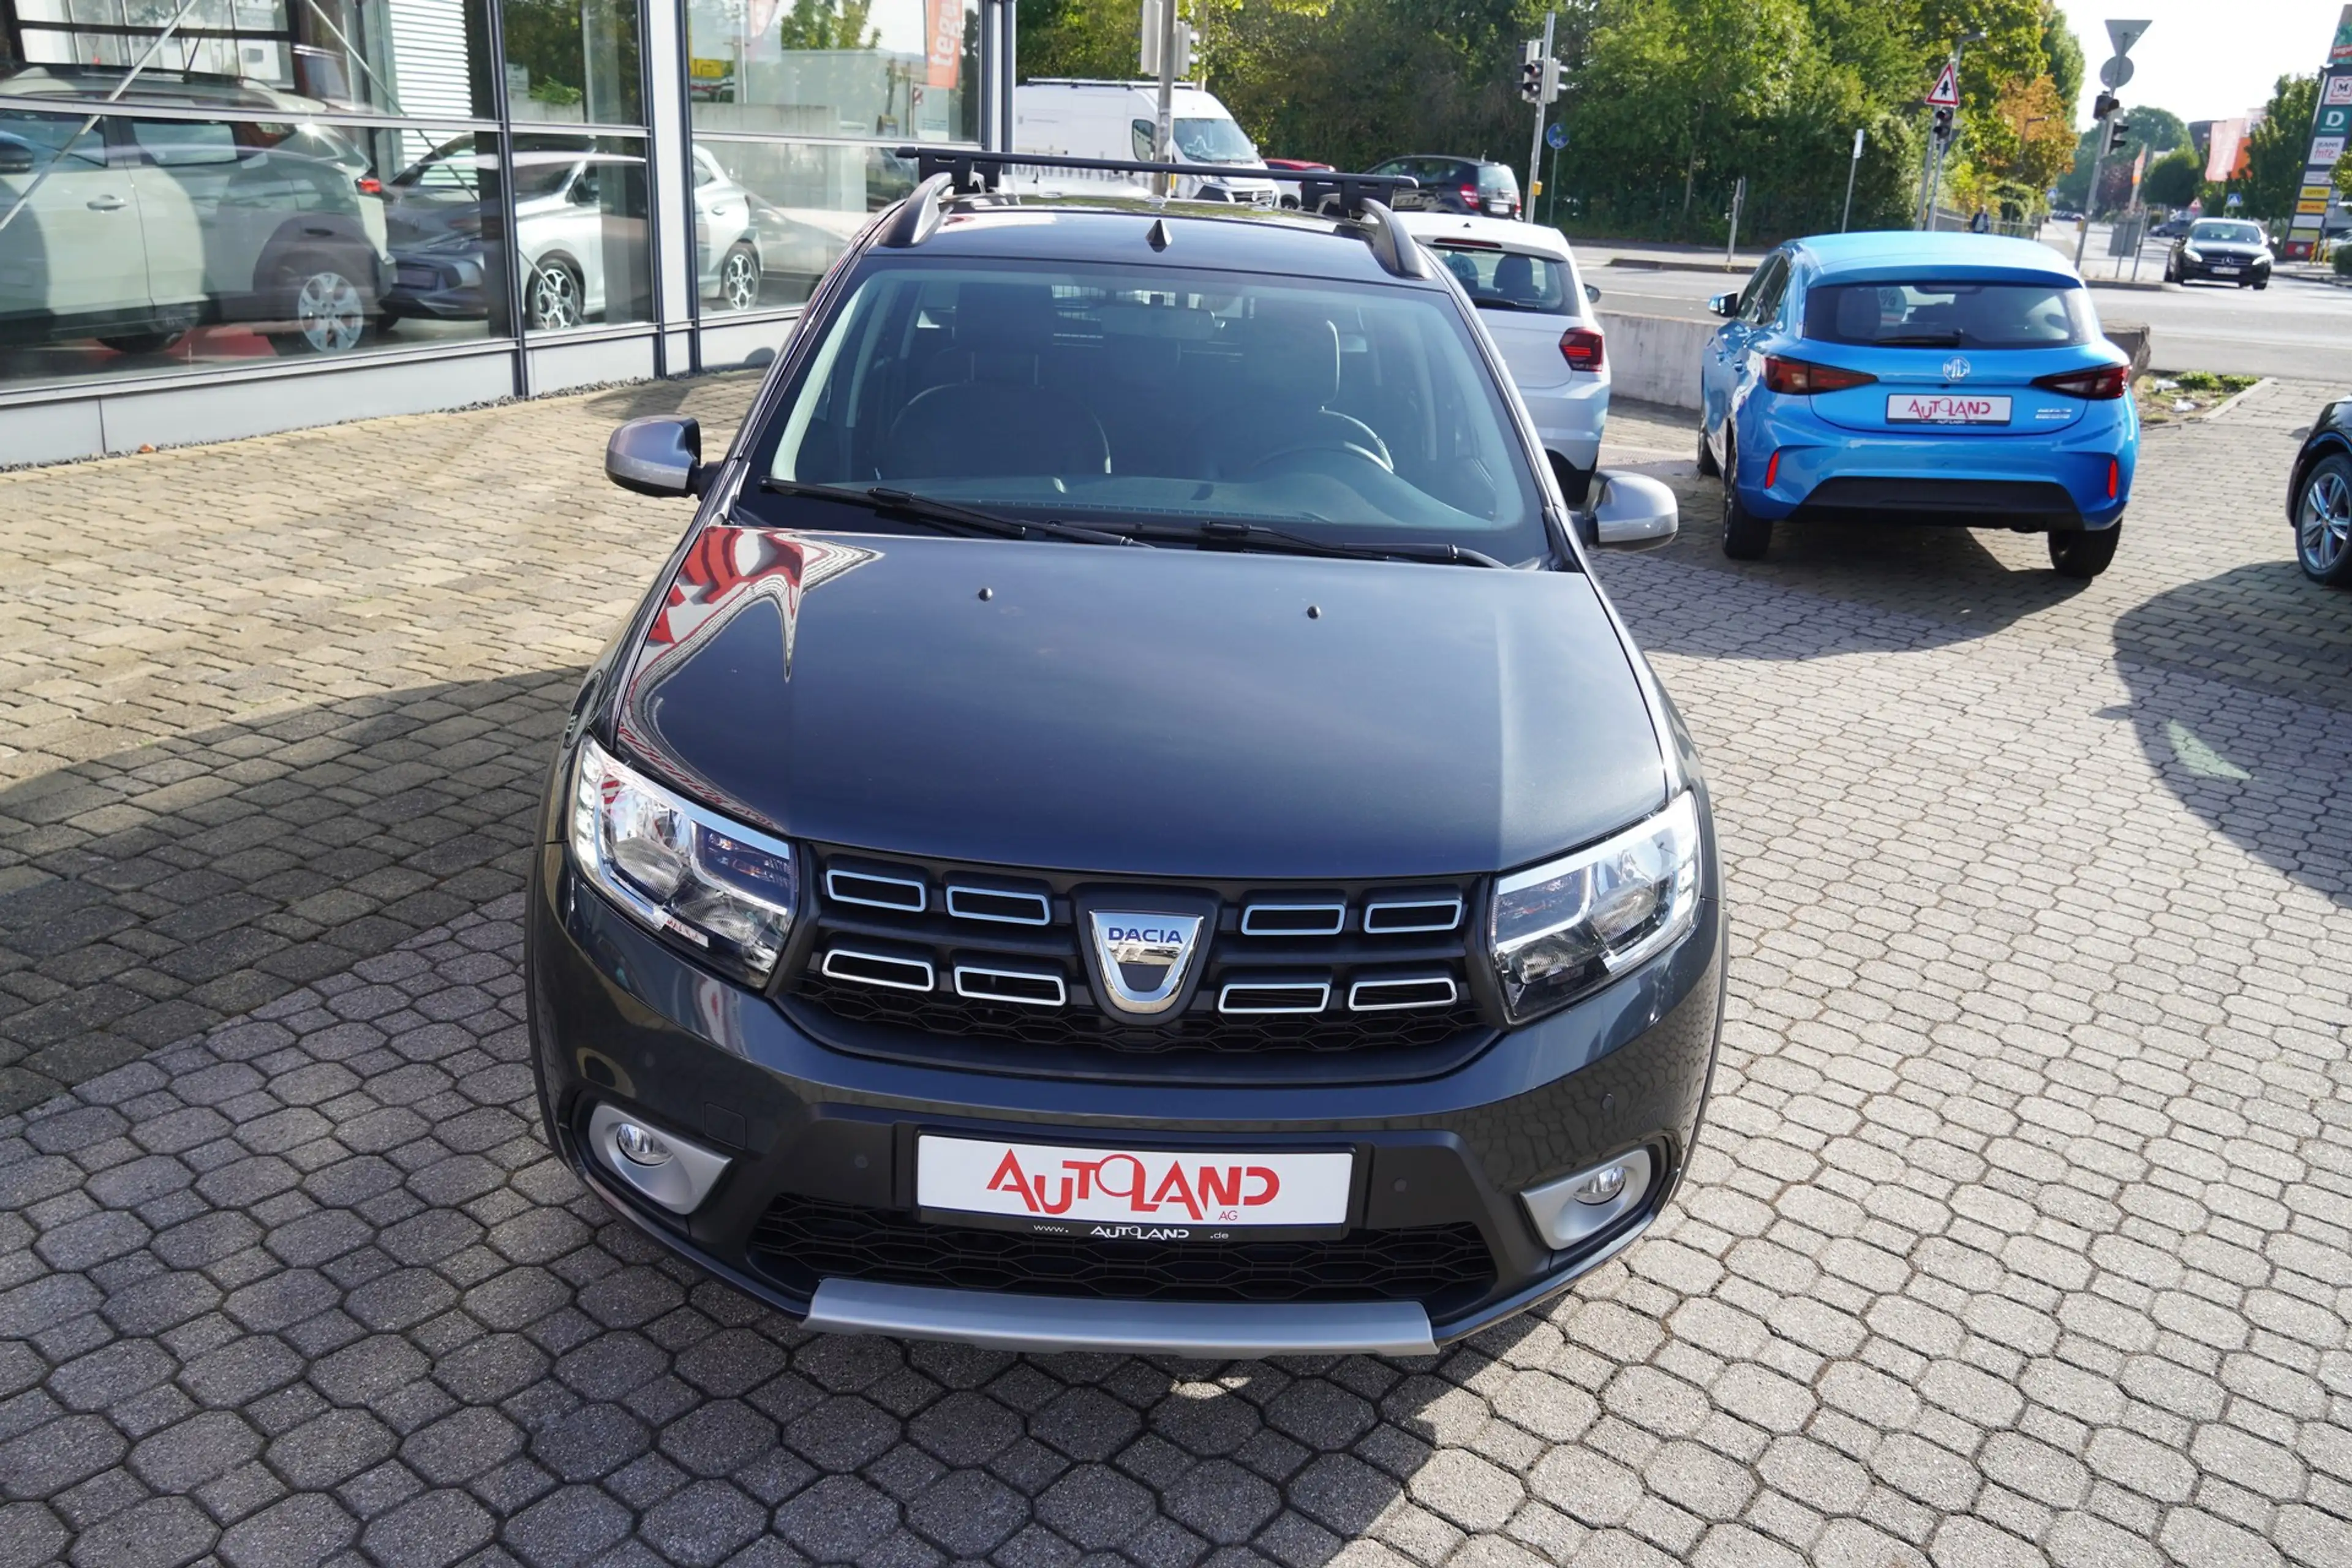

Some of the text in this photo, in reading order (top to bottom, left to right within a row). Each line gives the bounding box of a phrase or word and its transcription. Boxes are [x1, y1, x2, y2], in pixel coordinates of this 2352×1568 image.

[930, 0, 960, 67] tegu
[2325, 111, 2345, 127] D
[1943, 358, 1970, 379] MG
[1908, 398, 1991, 419] AUTOLAND
[1109, 927, 1183, 944] DACIA
[986, 1148, 1280, 1221] AUTOLAND
[1218, 1210, 1238, 1221] AG
[1033, 1224, 1069, 1233] www.
[1090, 1225, 1189, 1240] AUTOLAND
